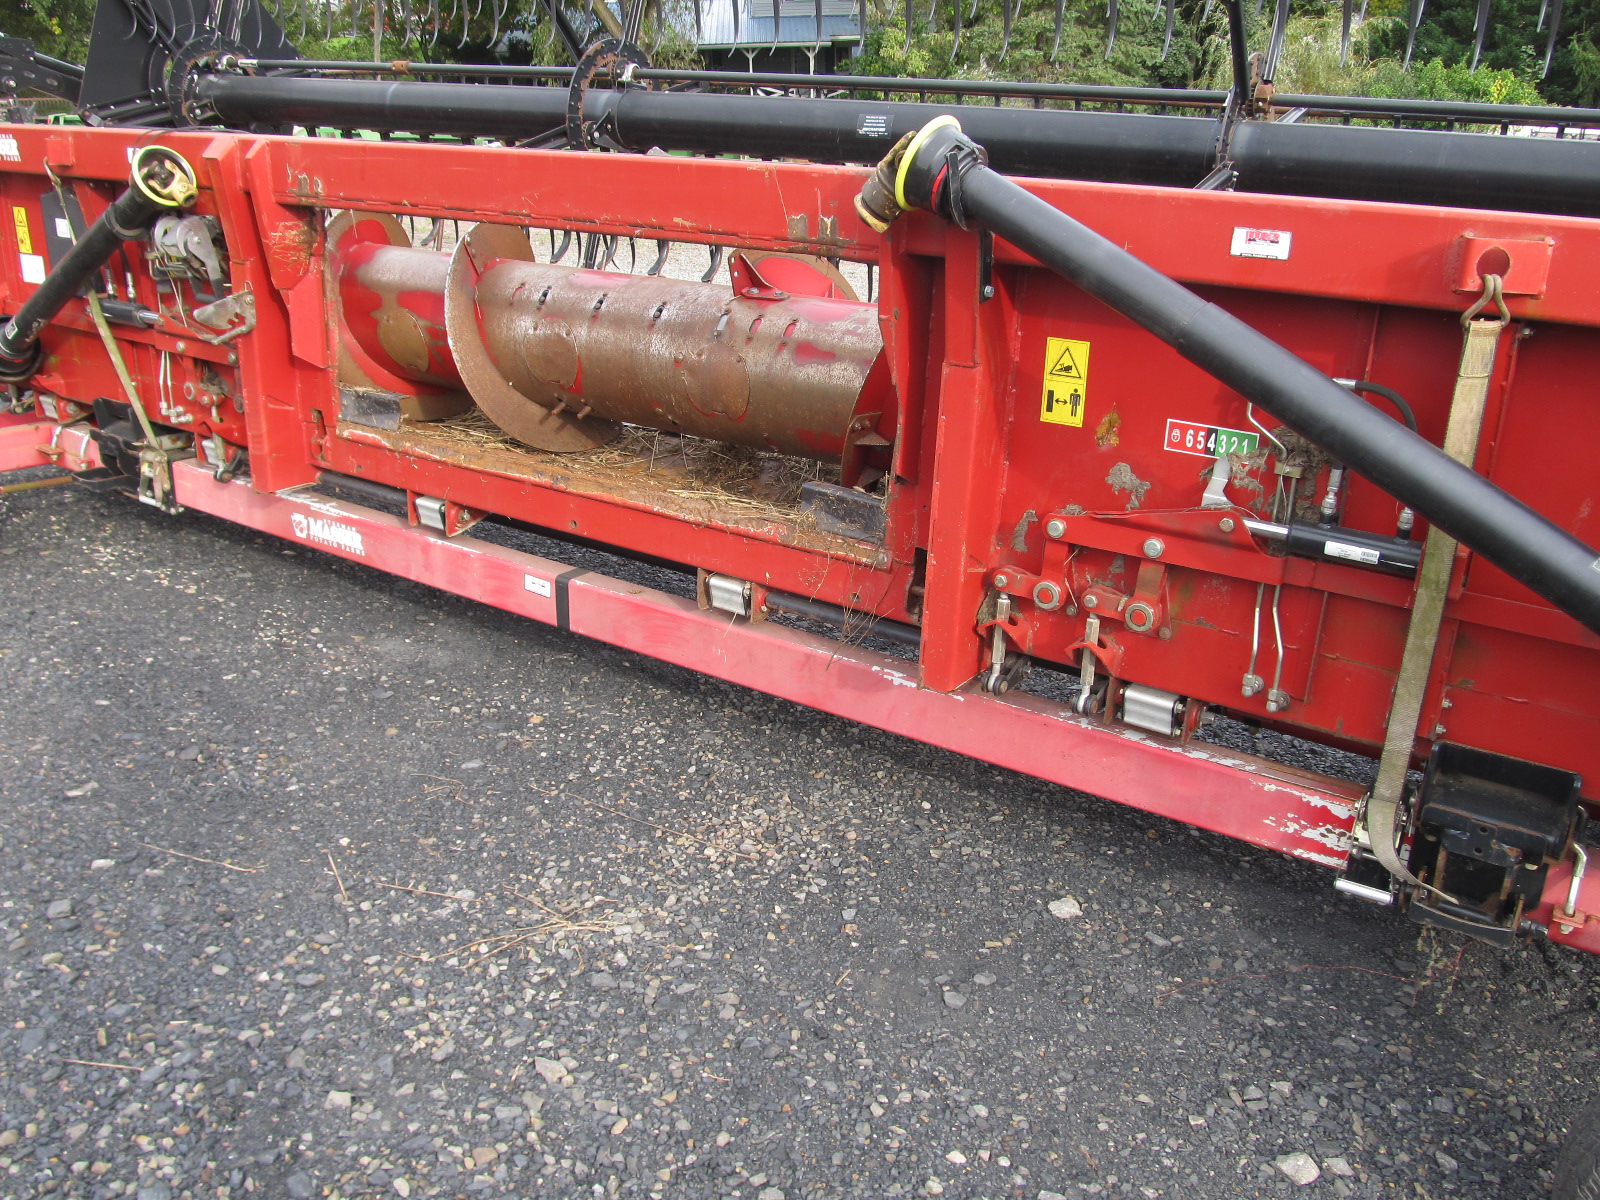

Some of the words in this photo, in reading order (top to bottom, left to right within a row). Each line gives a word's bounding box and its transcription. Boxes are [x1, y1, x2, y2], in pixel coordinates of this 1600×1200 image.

[308, 516, 364, 551] MASSER
[310, 534, 338, 548] POTATO
[341, 544, 366, 557] FARMS
